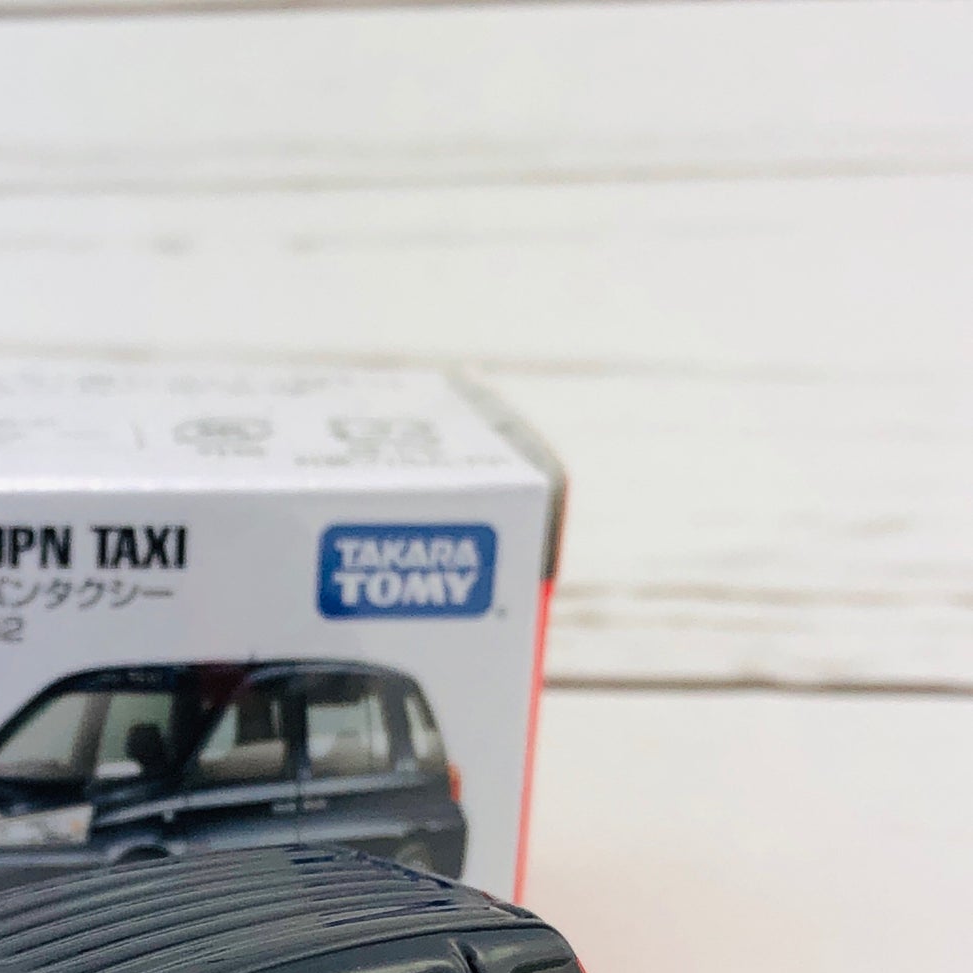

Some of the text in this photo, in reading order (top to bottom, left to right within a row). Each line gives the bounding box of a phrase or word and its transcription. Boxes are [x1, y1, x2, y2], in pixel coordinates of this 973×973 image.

[90, 525, 187, 569] TAXI
[334, 538, 478, 567] TAKARA
[333, 572, 477, 607] TOMY
